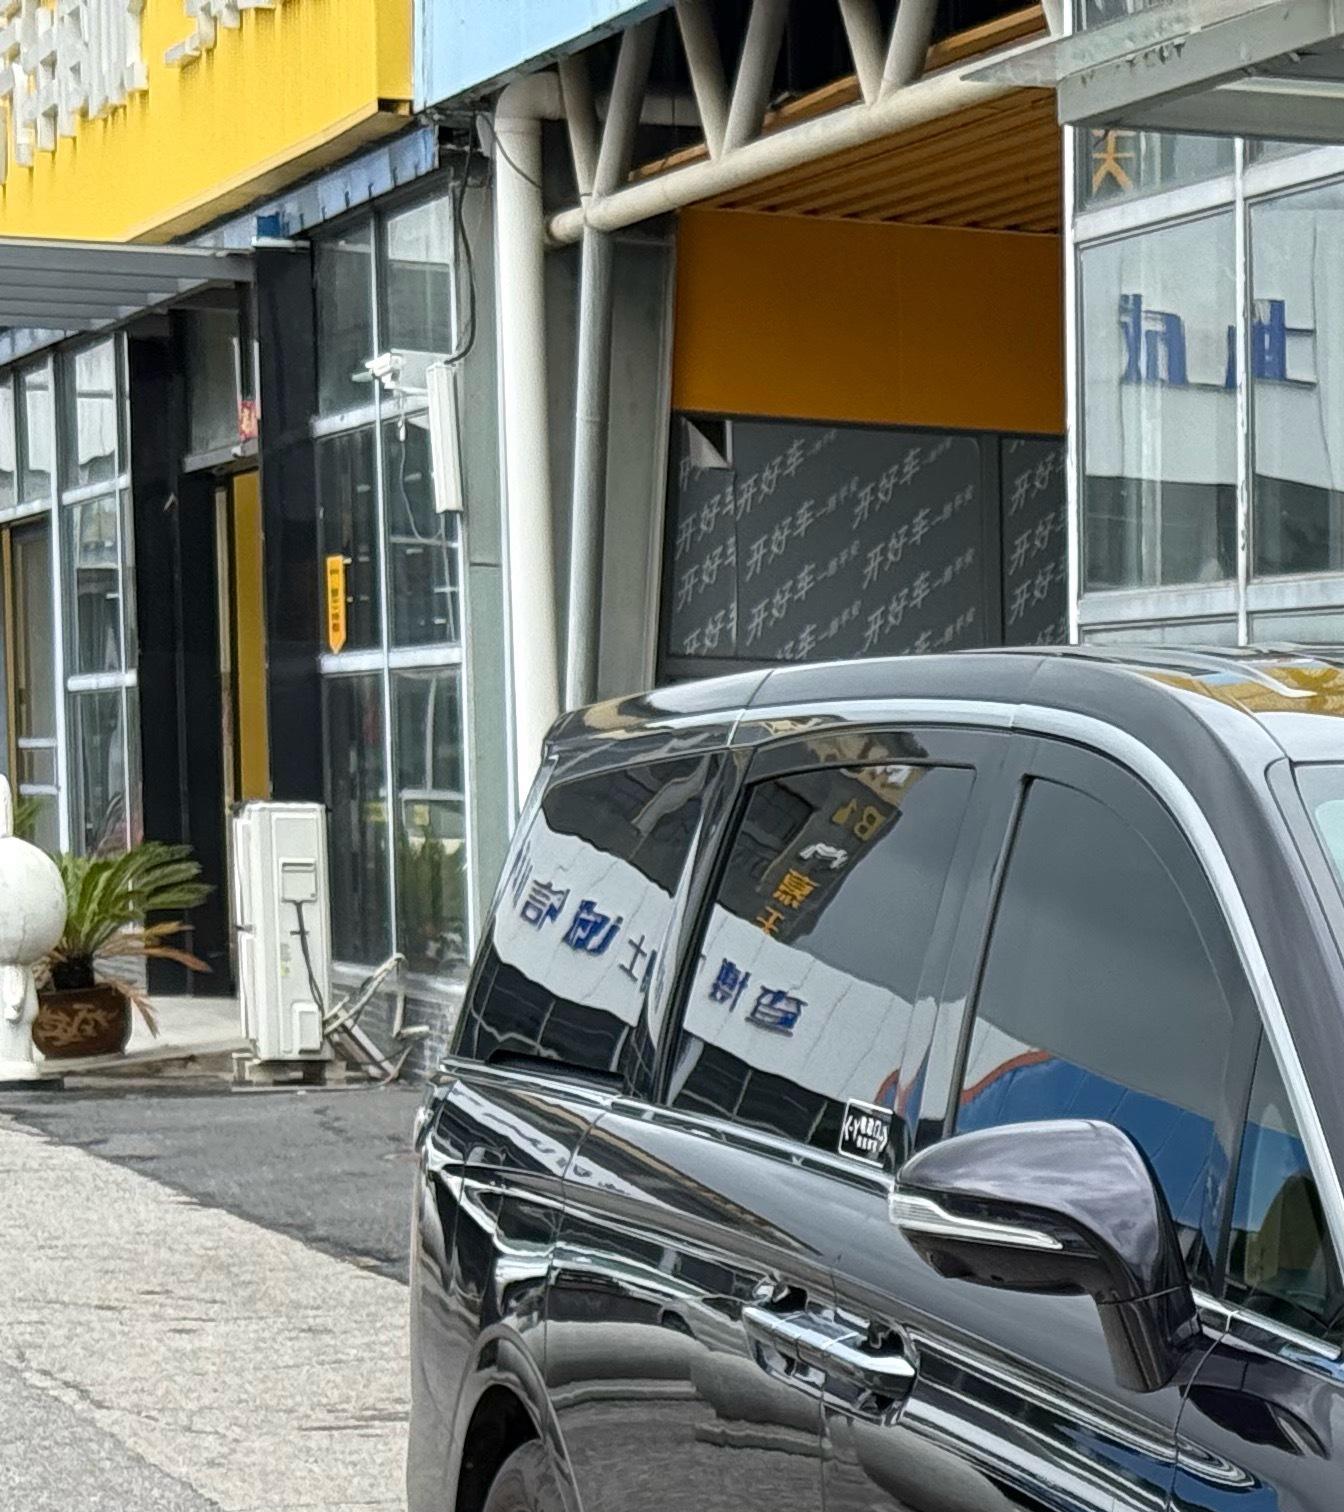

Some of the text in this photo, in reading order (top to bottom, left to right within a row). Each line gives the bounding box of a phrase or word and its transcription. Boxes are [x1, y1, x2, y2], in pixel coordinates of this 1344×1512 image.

[745, 499, 815, 583] 开好车
[862, 507, 932, 590] 开好车
[745, 562, 816, 648] 开好车
[862, 570, 932, 653] 开好车
